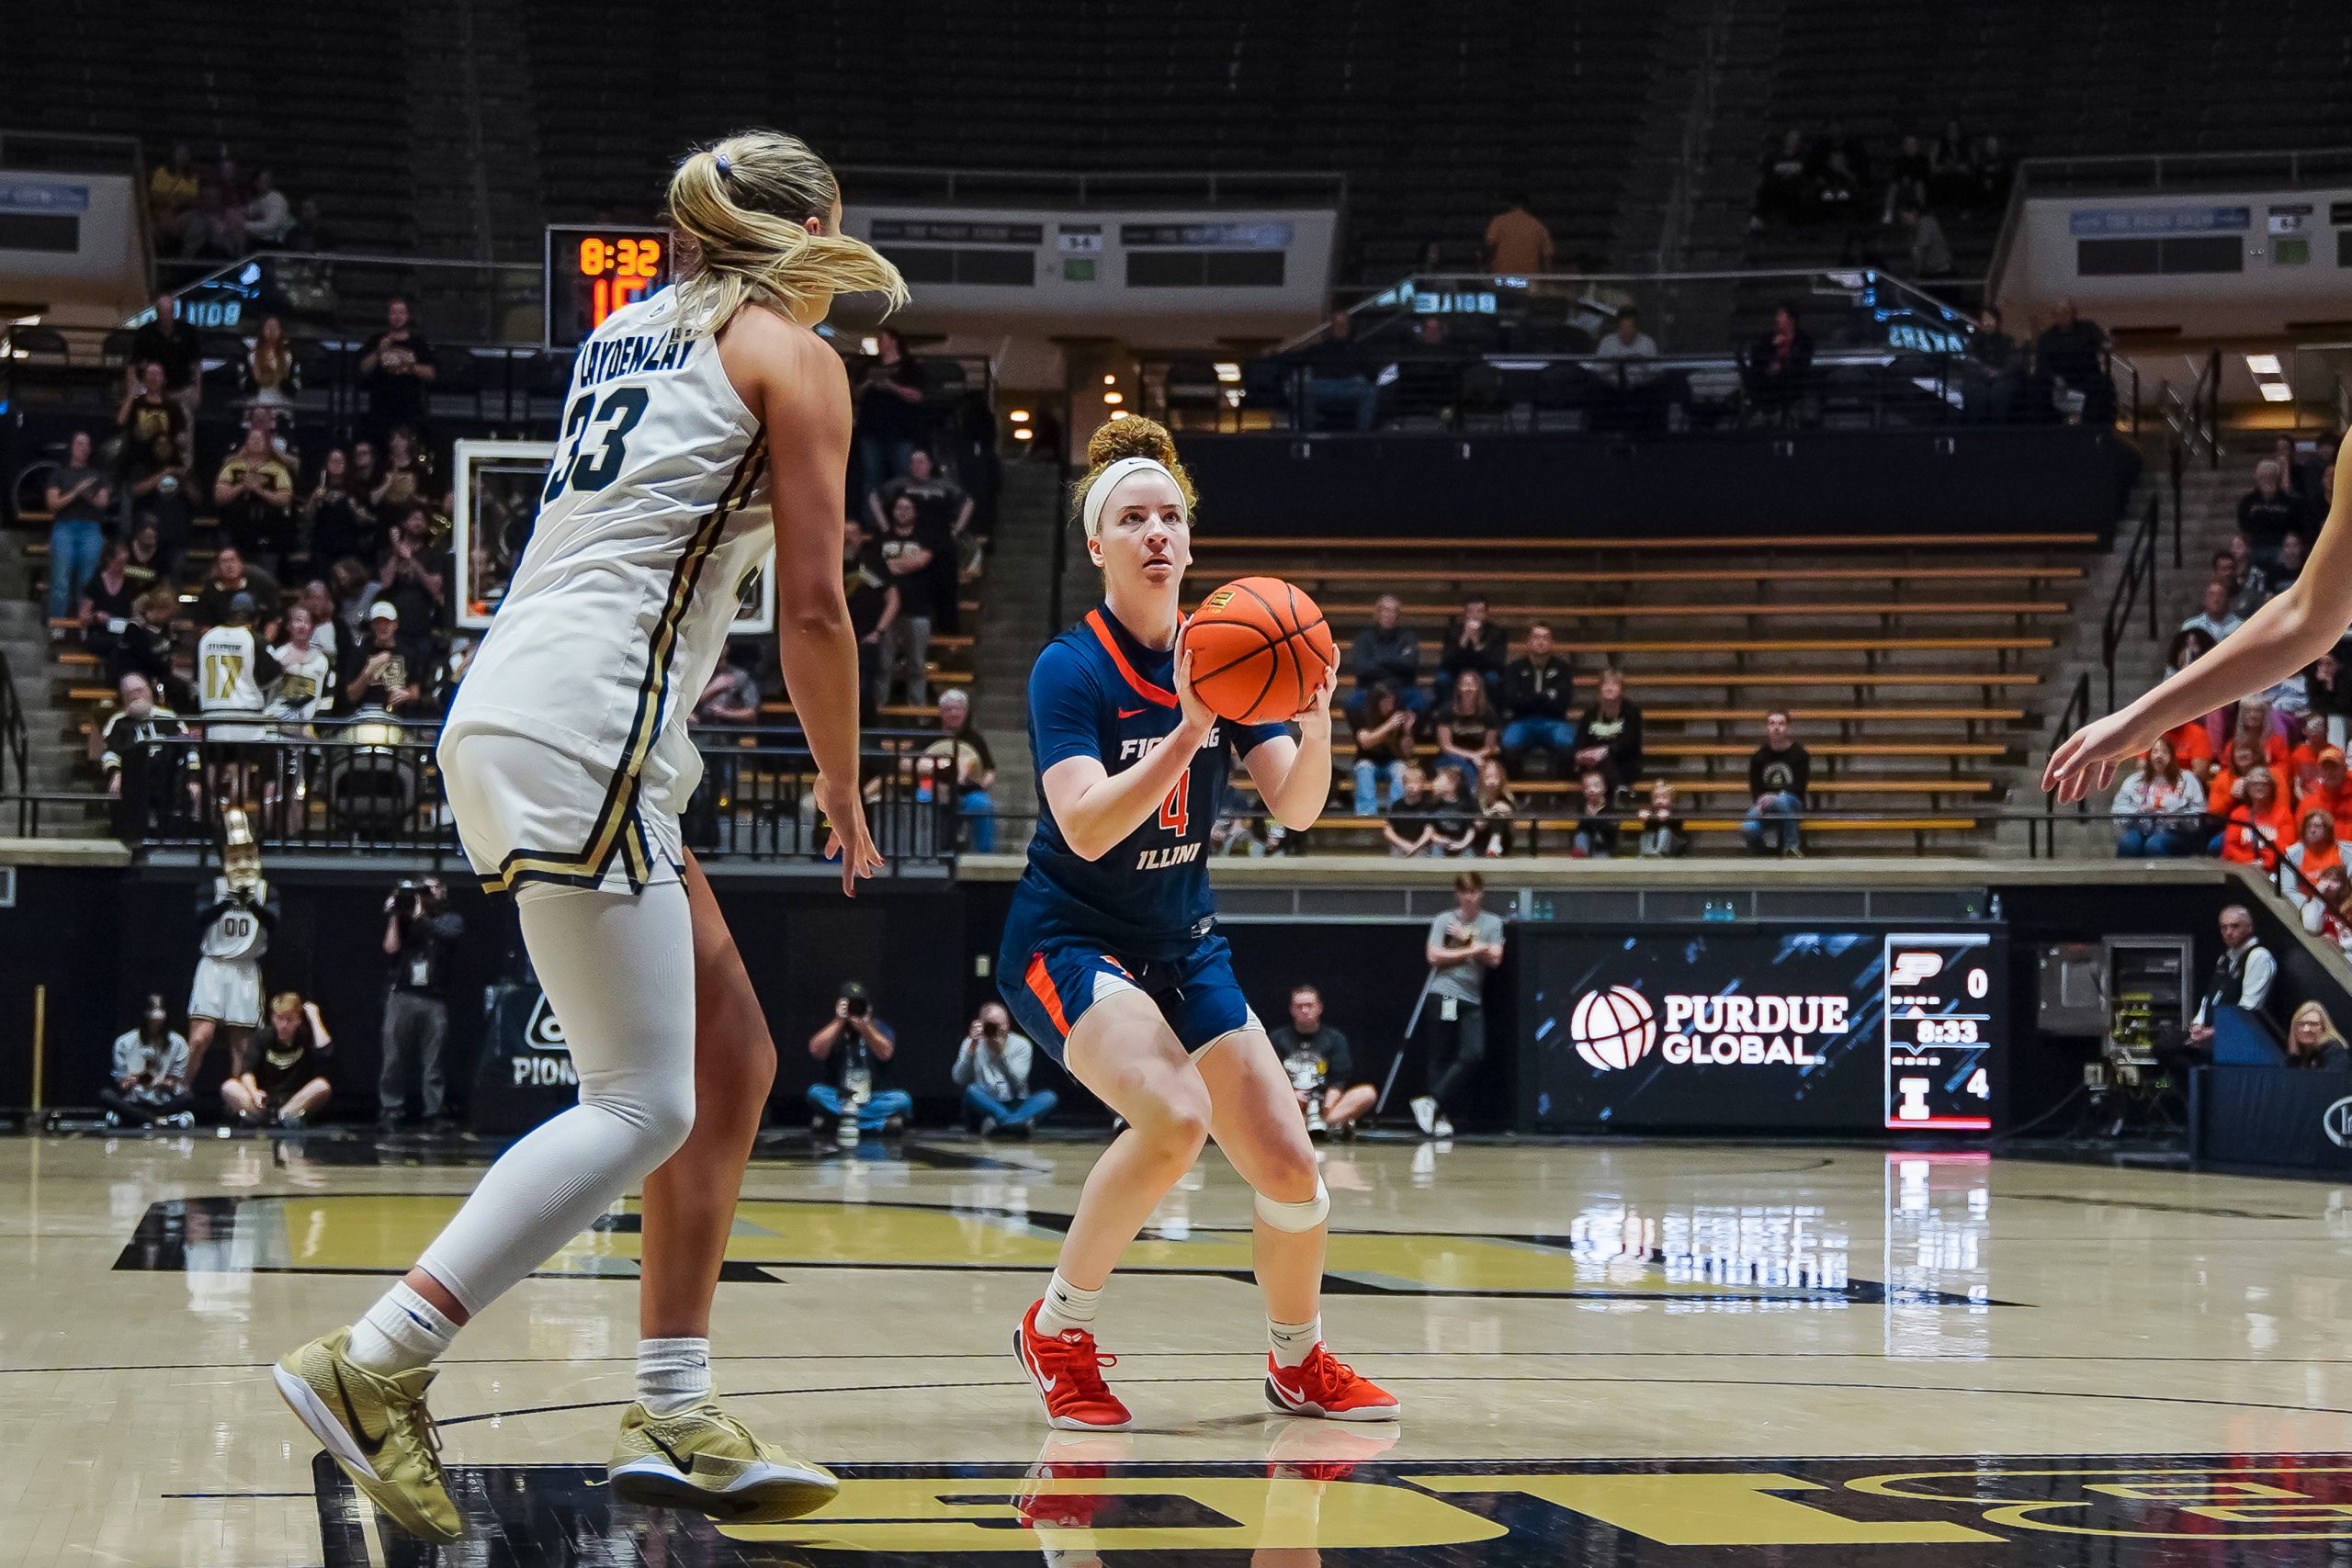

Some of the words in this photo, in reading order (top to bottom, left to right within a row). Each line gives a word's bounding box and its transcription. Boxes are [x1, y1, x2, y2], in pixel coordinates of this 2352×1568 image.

[580, 237, 661, 277] 8:32
[542, 387, 651, 503] 33
[205, 654, 244, 700] 17
[1159, 767, 1191, 838] 4
[1136, 842, 1203, 871] ILLINI
[224, 918, 249, 938] 00
[1967, 968, 1989, 999] 0
[1663, 995, 1849, 1034] PURDUE
[1917, 1020, 1979, 1044] 8:33
[1661, 1033, 1817, 1066] GLOBAL
[1966, 1067, 1990, 1099] 4
